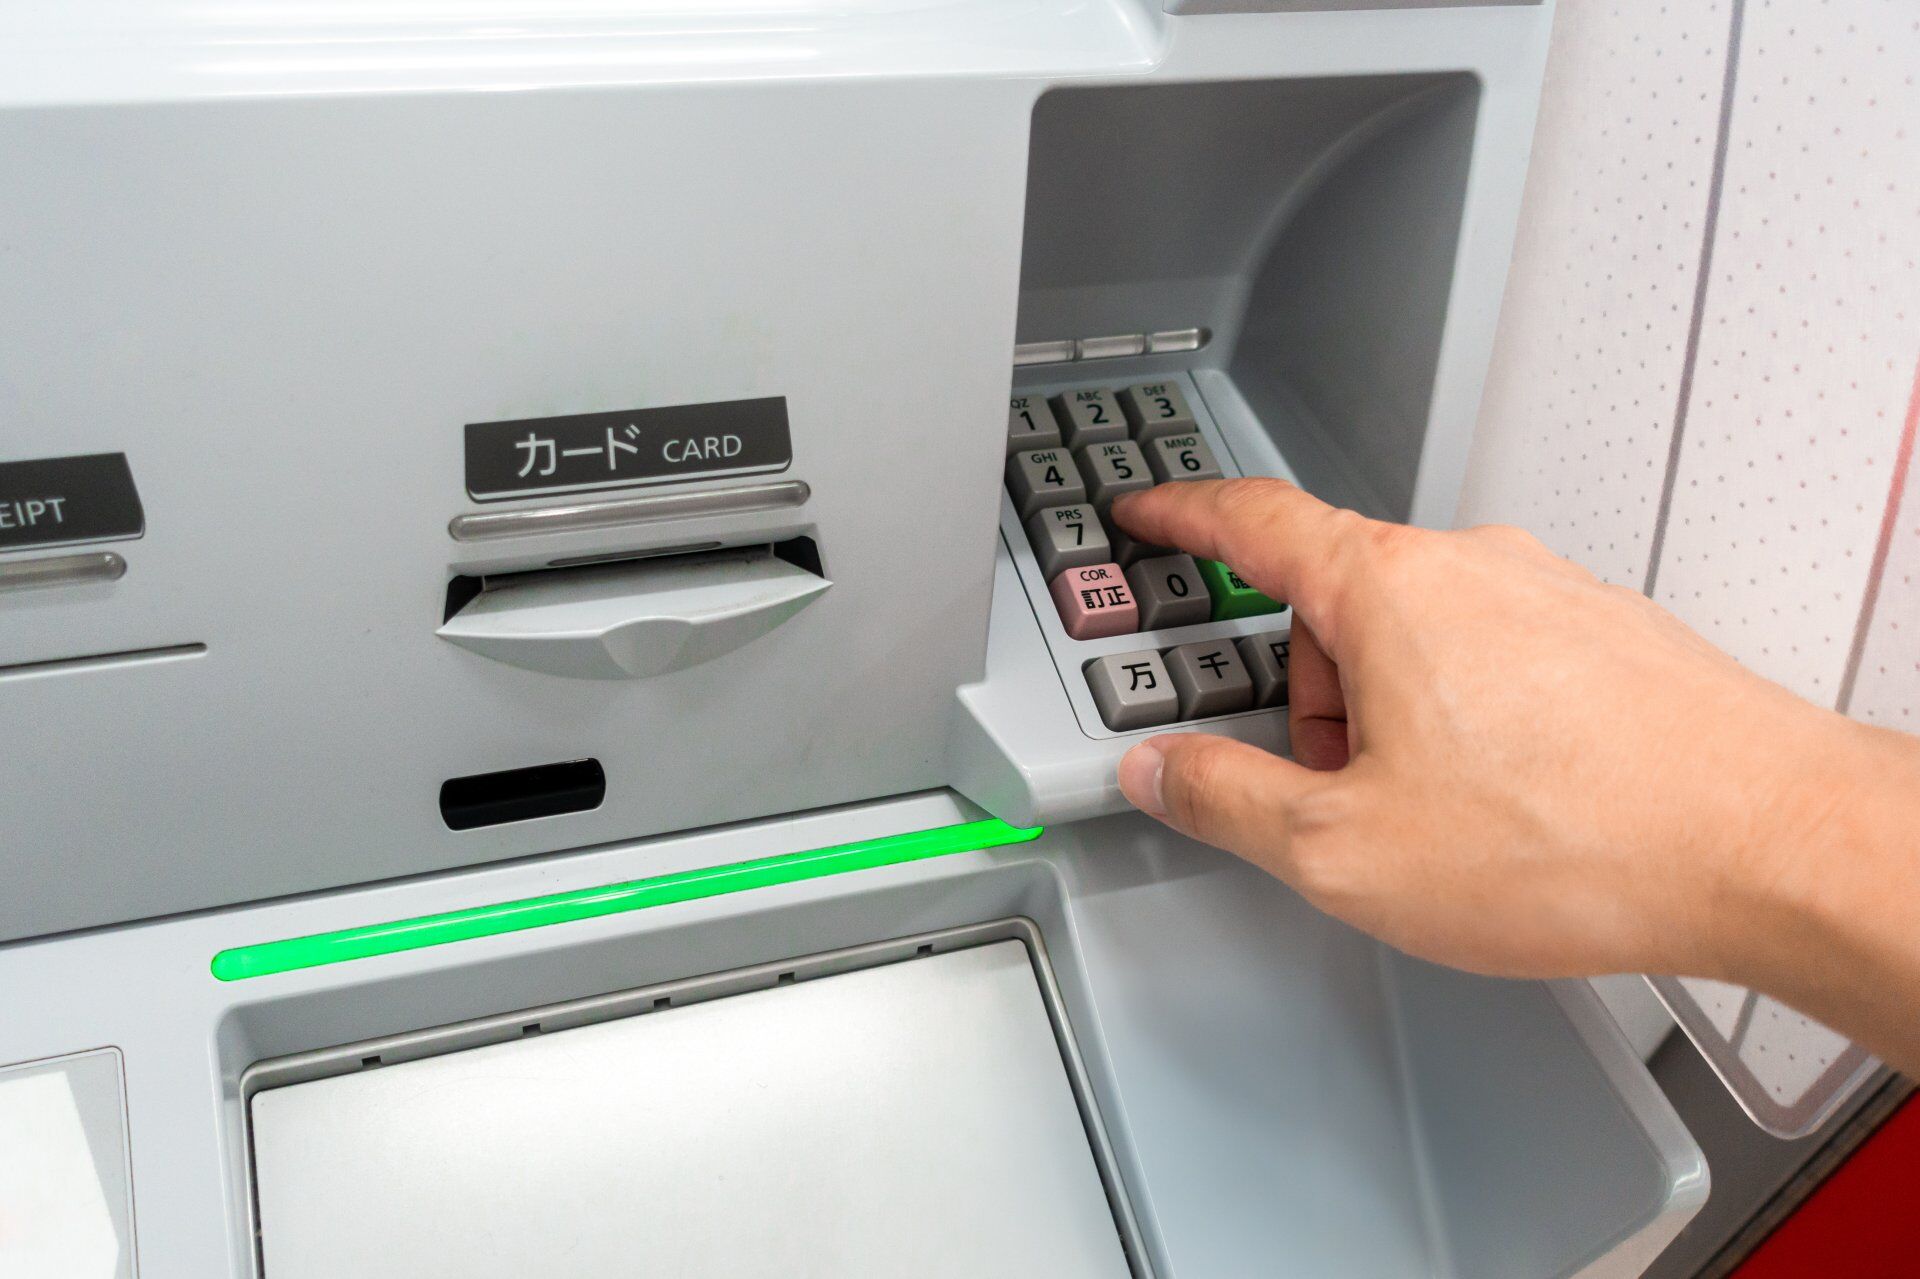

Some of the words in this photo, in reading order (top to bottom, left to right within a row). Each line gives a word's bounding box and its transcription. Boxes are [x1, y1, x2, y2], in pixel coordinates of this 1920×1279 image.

[1076, 391, 1102, 402] ABC
[1143, 385, 1168, 396] DEF
[1088, 404, 1109, 424] 2
[1155, 398, 1176, 418] 3
[1020, 410, 1036, 430] 1
[516, 424, 640, 478] カード
[663, 435, 742, 463] CARD
[1103, 446, 1126, 456] JKL
[1165, 437, 1197, 449] MNO
[1031, 452, 1058, 464] GHI
[1180, 450, 1201, 472] 6
[1045, 465, 1065, 486] 4
[1111, 458, 1133, 479] 5
[0, 498, 66, 528] EIPT
[1056, 509, 1082, 521] PRS
[1065, 523, 1084, 546] 7
[1080, 568, 1112, 582] COR.
[1167, 574, 1189, 597] 0
[1080, 585, 1131, 609] 訂正
[1198, 651, 1230, 679] 千
[1121, 661, 1157, 691] 万
